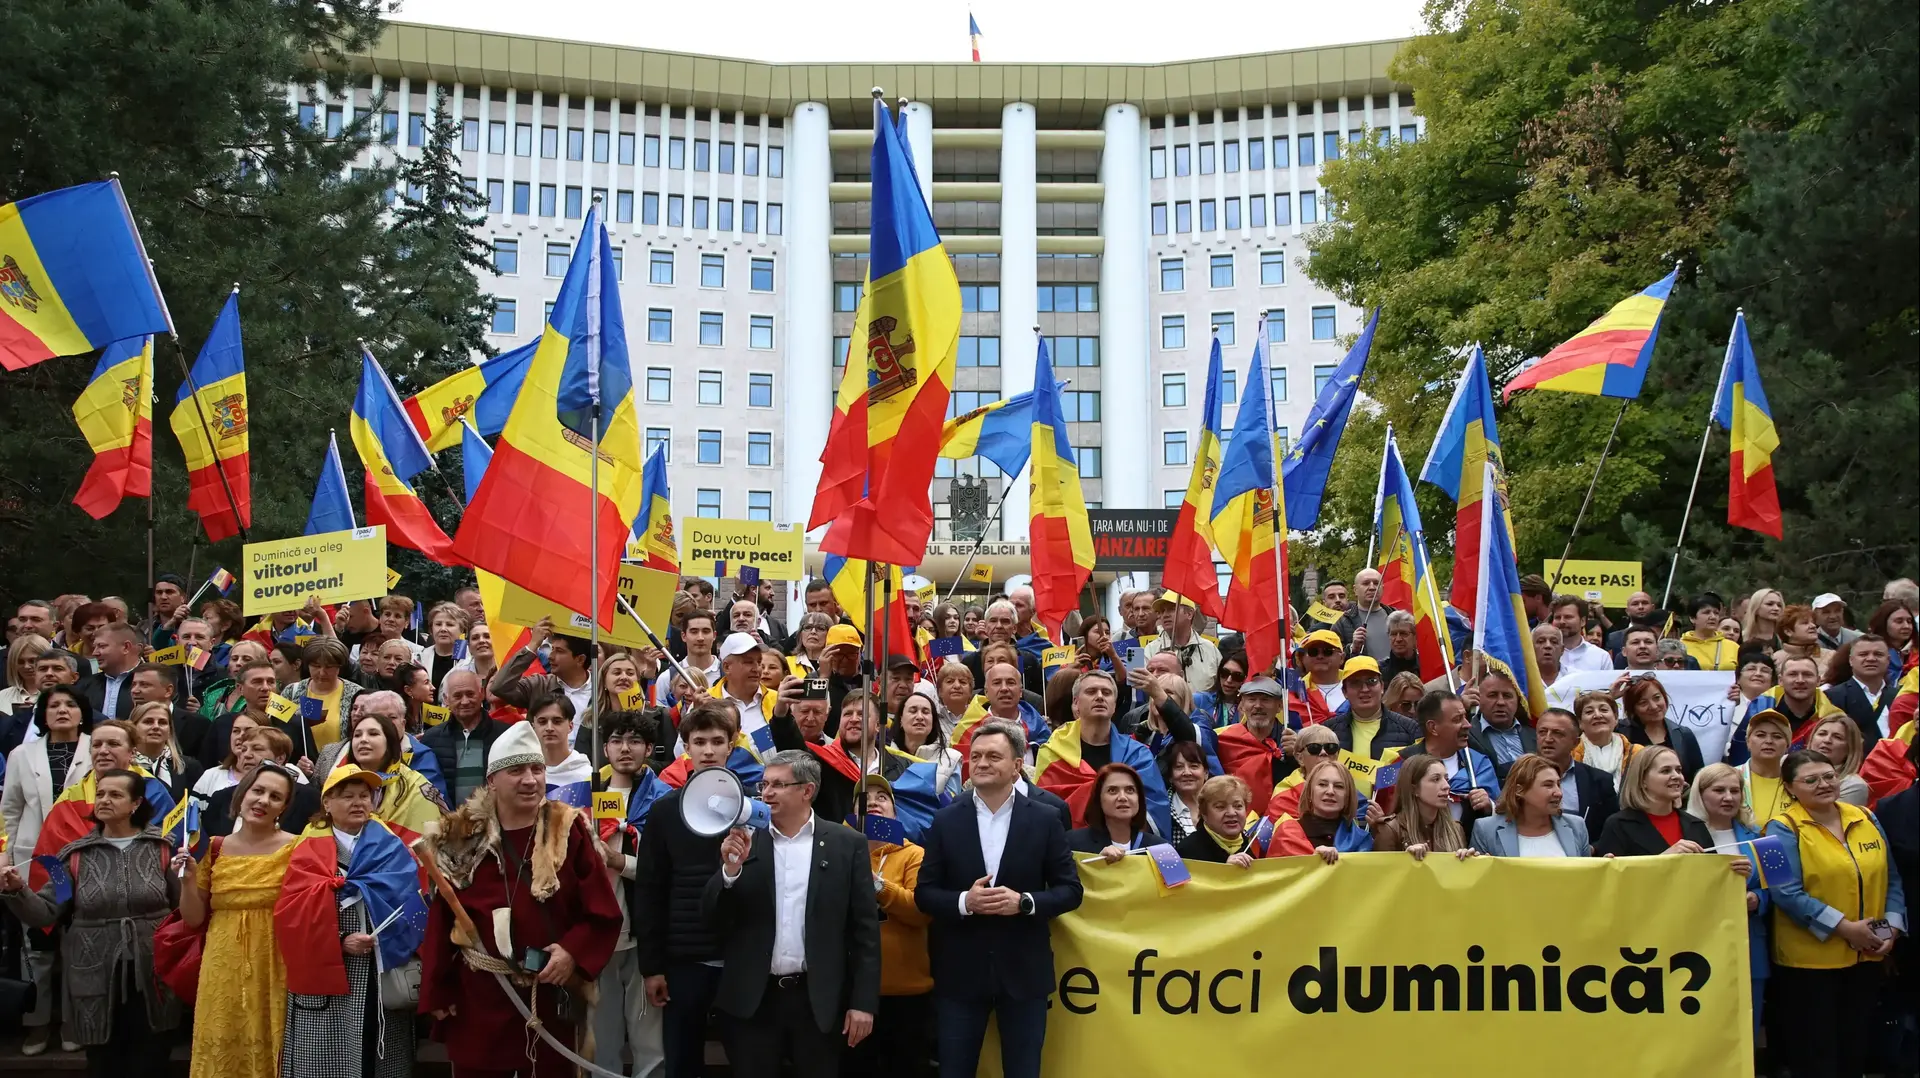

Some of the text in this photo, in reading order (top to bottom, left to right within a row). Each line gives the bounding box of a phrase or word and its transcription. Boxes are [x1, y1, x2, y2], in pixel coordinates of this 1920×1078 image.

[1093, 520, 1168, 535] ȚARA MEA NU-I DE
[693, 531, 760, 546] Dau votul
[253, 542, 343, 562] Duminică eu aleg
[692, 548, 792, 563] pentru pace!
[950, 545, 1015, 555] REPUBLICII
[253, 557, 318, 580] viitorul
[253, 573, 344, 599] european!
[1551, 573, 1635, 587] Votez PAS!
[1047, 944, 1712, 1016] e faci duminică?
